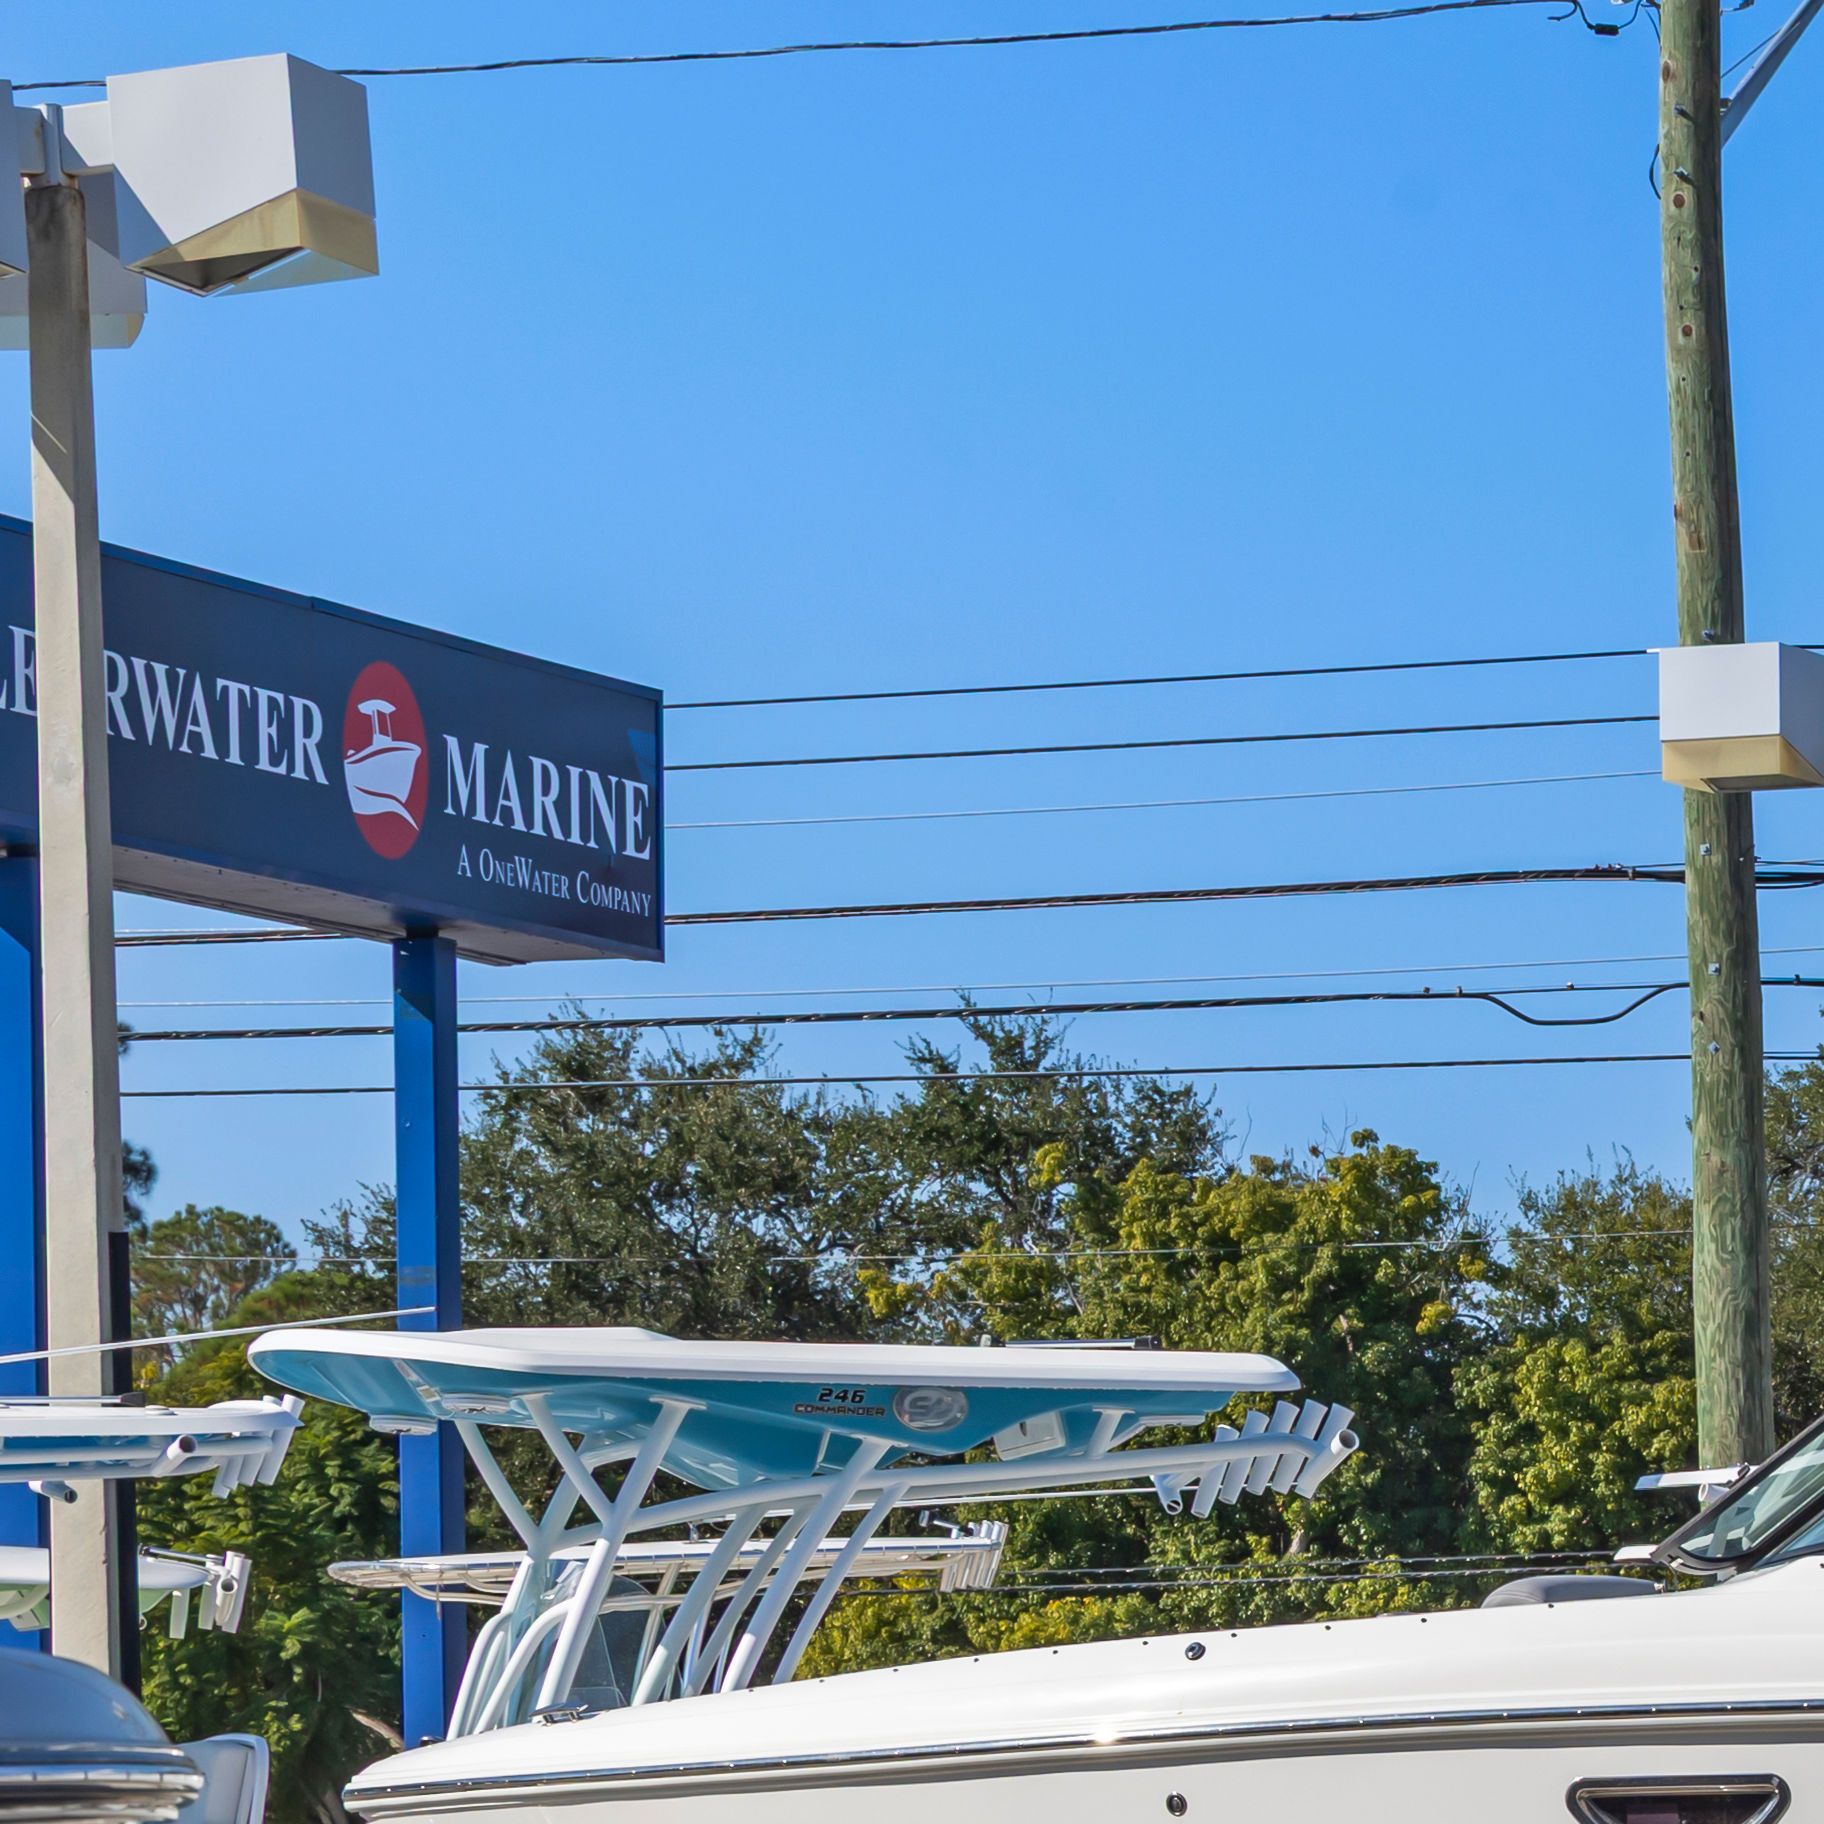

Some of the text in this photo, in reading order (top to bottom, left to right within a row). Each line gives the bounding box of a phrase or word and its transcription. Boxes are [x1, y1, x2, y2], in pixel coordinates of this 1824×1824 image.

[443, 734, 652, 861] MARINE
[457, 843, 472, 878] A
[818, 1387, 866, 1404] 246
[793, 1403, 886, 1417] COMMANDER
